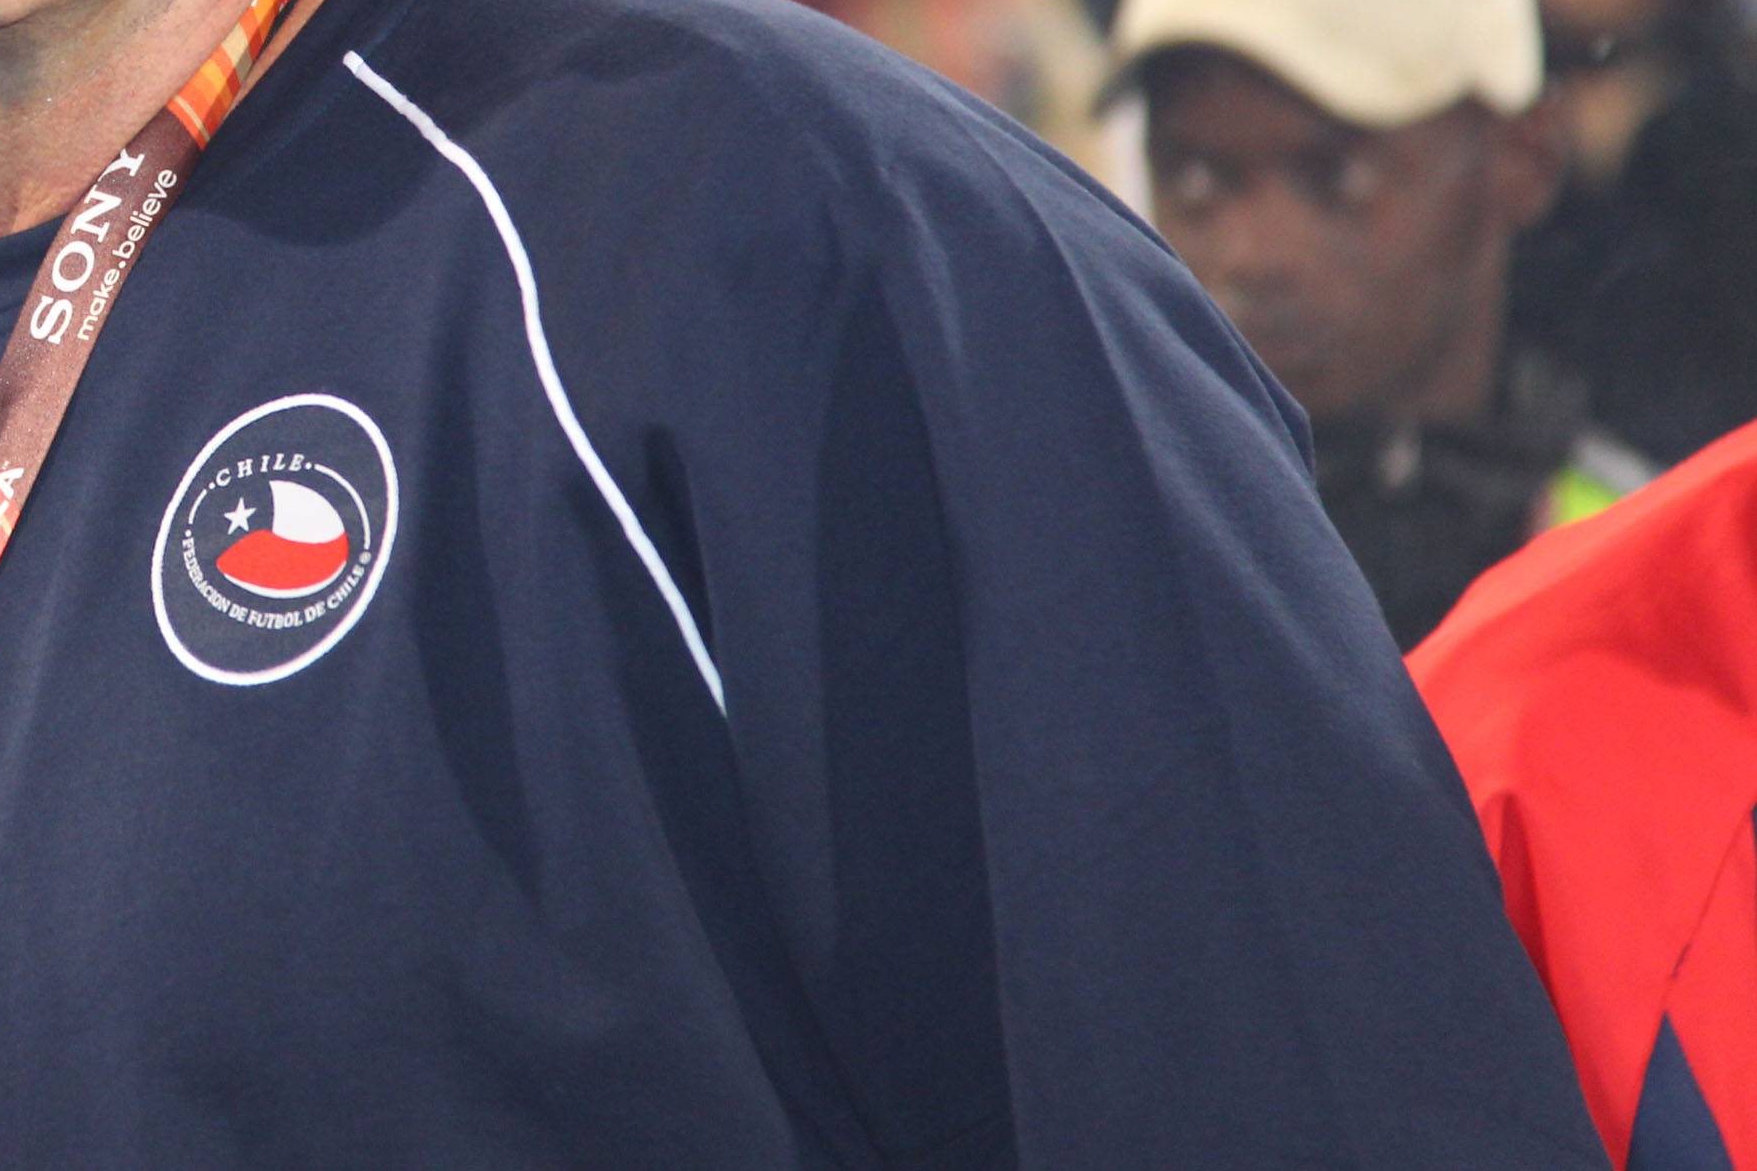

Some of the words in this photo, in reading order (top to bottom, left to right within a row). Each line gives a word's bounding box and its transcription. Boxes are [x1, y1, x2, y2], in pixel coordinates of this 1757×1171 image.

[30, 148, 145, 345] SONY
[77, 169, 178, 341] make.believe
[216, 453, 305, 488] CHILE
[229, 605, 247, 623] DE
[247, 608, 304, 629] FUTBOL
[304, 601, 327, 623] DE
[326, 564, 366, 611] CHILE
